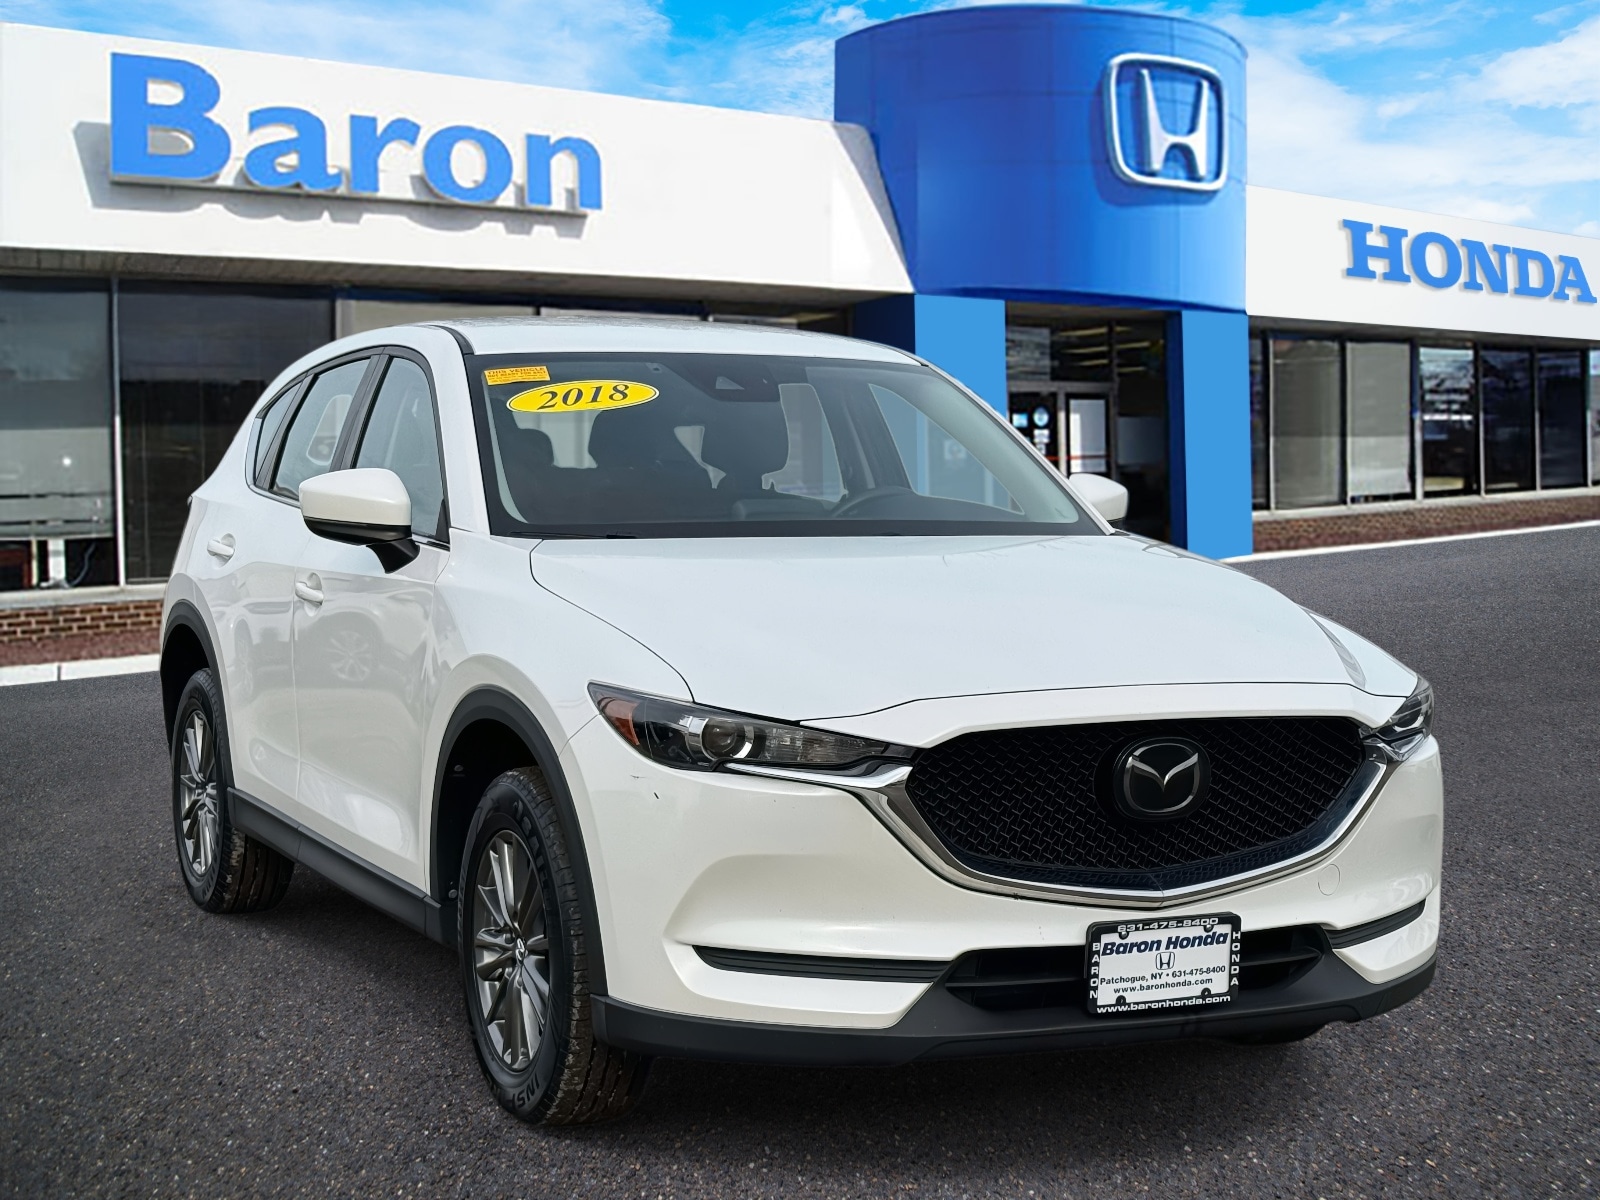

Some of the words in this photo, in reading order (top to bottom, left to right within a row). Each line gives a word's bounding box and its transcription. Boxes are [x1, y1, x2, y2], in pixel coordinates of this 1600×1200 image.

[111, 52, 602, 210] Baron
[1342, 219, 1598, 304] HONDA
[536, 384, 629, 410] 2018
[1118, 918, 1219, 932] 631-475-8400
[1101, 939, 1162, 956] Baron
[1165, 931, 1229, 950] Honda
[1089, 942, 1100, 999] BARON
[1230, 931, 1241, 986] HONDA
[1100, 975, 1149, 986] Patchogue,
[1151, 972, 1163, 981] NY
[1171, 965, 1226, 978] 631-475-8400
[1113, 978, 1213, 994] www.baronhonda.com
[1097, 996, 1231, 1013] www.baronhonda.com
